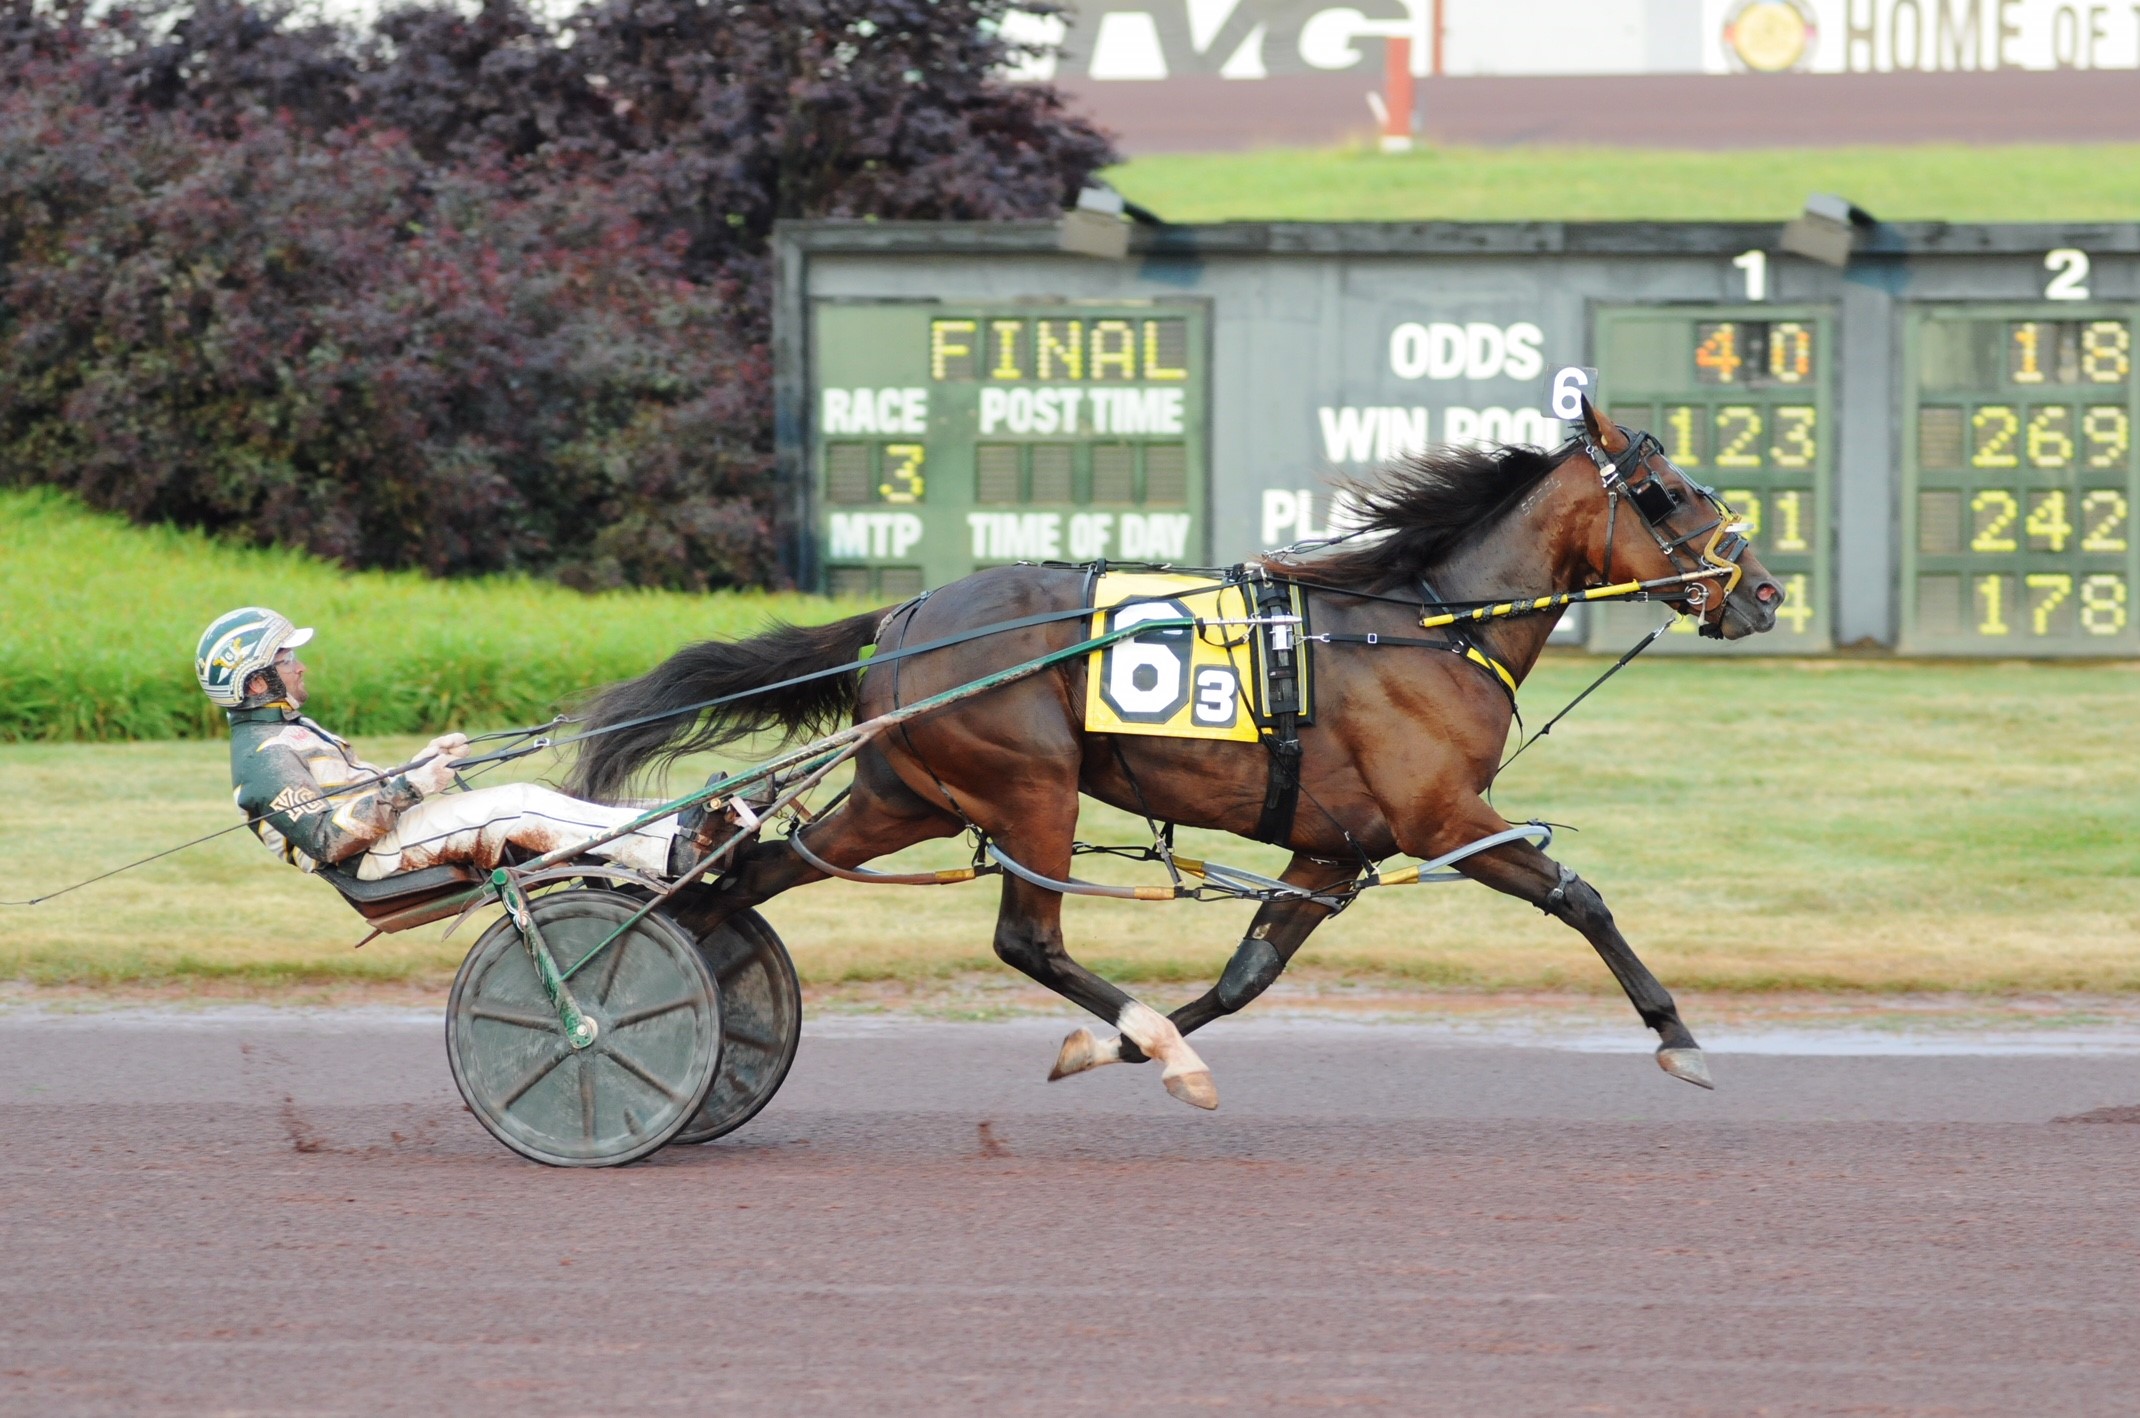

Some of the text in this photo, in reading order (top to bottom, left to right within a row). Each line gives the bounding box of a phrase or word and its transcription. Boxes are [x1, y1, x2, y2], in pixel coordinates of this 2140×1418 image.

[1845, 0, 2023, 71] HOME
[2053, 5, 2108, 69] OF
[1733, 250, 1766, 300] 1
[2044, 249, 2091, 300] 2
[931, 320, 1188, 381] FINAL
[1389, 322, 1545, 380] ODDS
[822, 387, 929, 434] RACE
[979, 387, 1184, 434] POST TIME
[1552, 367, 1589, 420] 6
[1317, 405, 1429, 463] WIN
[1668, 405, 1818, 468] 123
[1971, 405, 2129, 468] 269
[879, 444, 926, 503] 3
[829, 512, 924, 559] MTP
[967, 512, 1192, 561] TIME OF DAY
[1971, 489, 2128, 552] 242
[1978, 573, 2128, 635] 178
[1110, 602, 1184, 713] 6
[1195, 669, 1236, 722] 3
